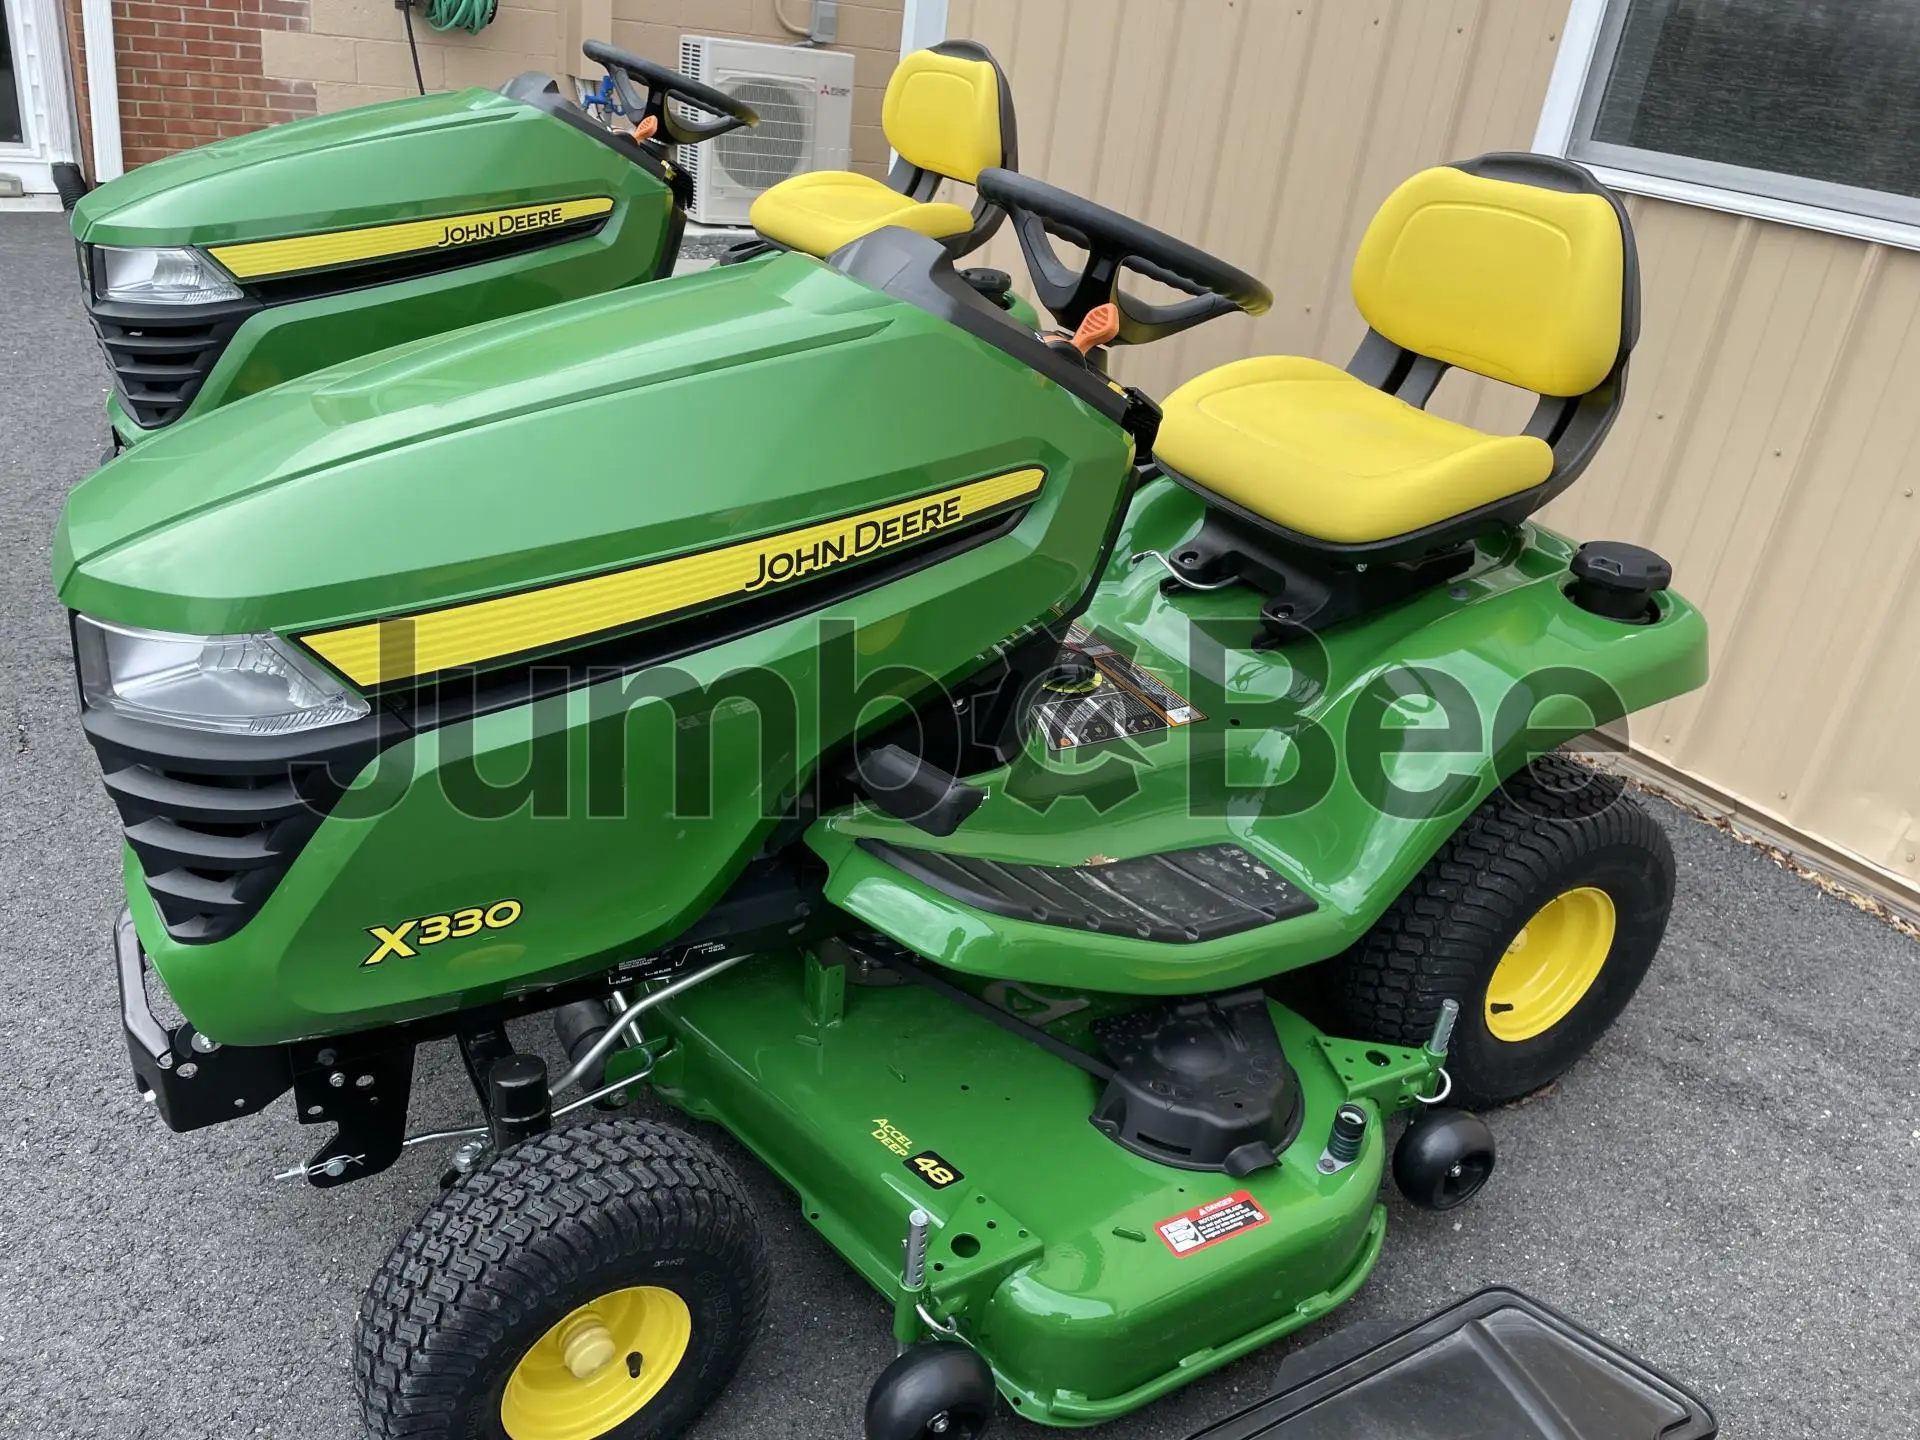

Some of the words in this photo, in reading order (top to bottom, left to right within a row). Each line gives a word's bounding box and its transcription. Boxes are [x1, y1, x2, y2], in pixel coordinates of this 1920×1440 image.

[437, 221, 495, 246] JOHN
[498, 208, 564, 235] DEERE
[744, 534, 846, 590] JOHN
[854, 495, 963, 555] DEERE
[361, 898, 523, 966] X330
[871, 1118, 913, 1150] ACCEL
[871, 1128, 909, 1157] DEEP
[913, 1157, 955, 1185] 48
[1203, 1196, 1235, 1213] DANGER
